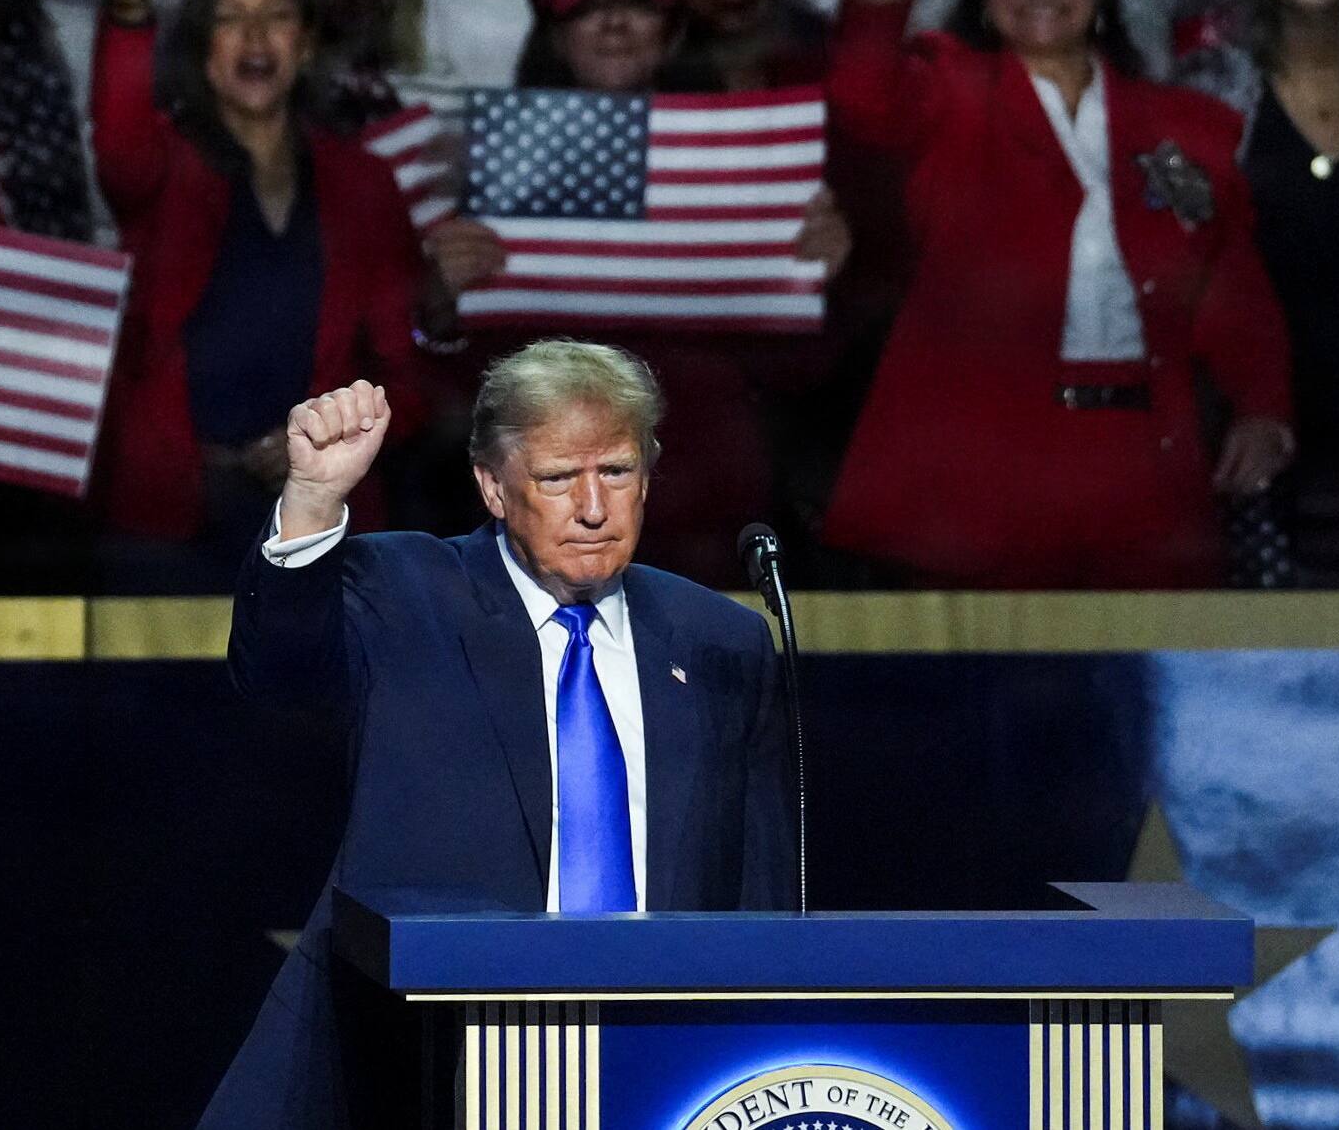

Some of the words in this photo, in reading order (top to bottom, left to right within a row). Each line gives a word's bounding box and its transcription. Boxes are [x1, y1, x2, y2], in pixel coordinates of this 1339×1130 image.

[702, 1079, 814, 1130] DENT
[826, 1085, 859, 1106] OF
[866, 1092, 911, 1130] THE
